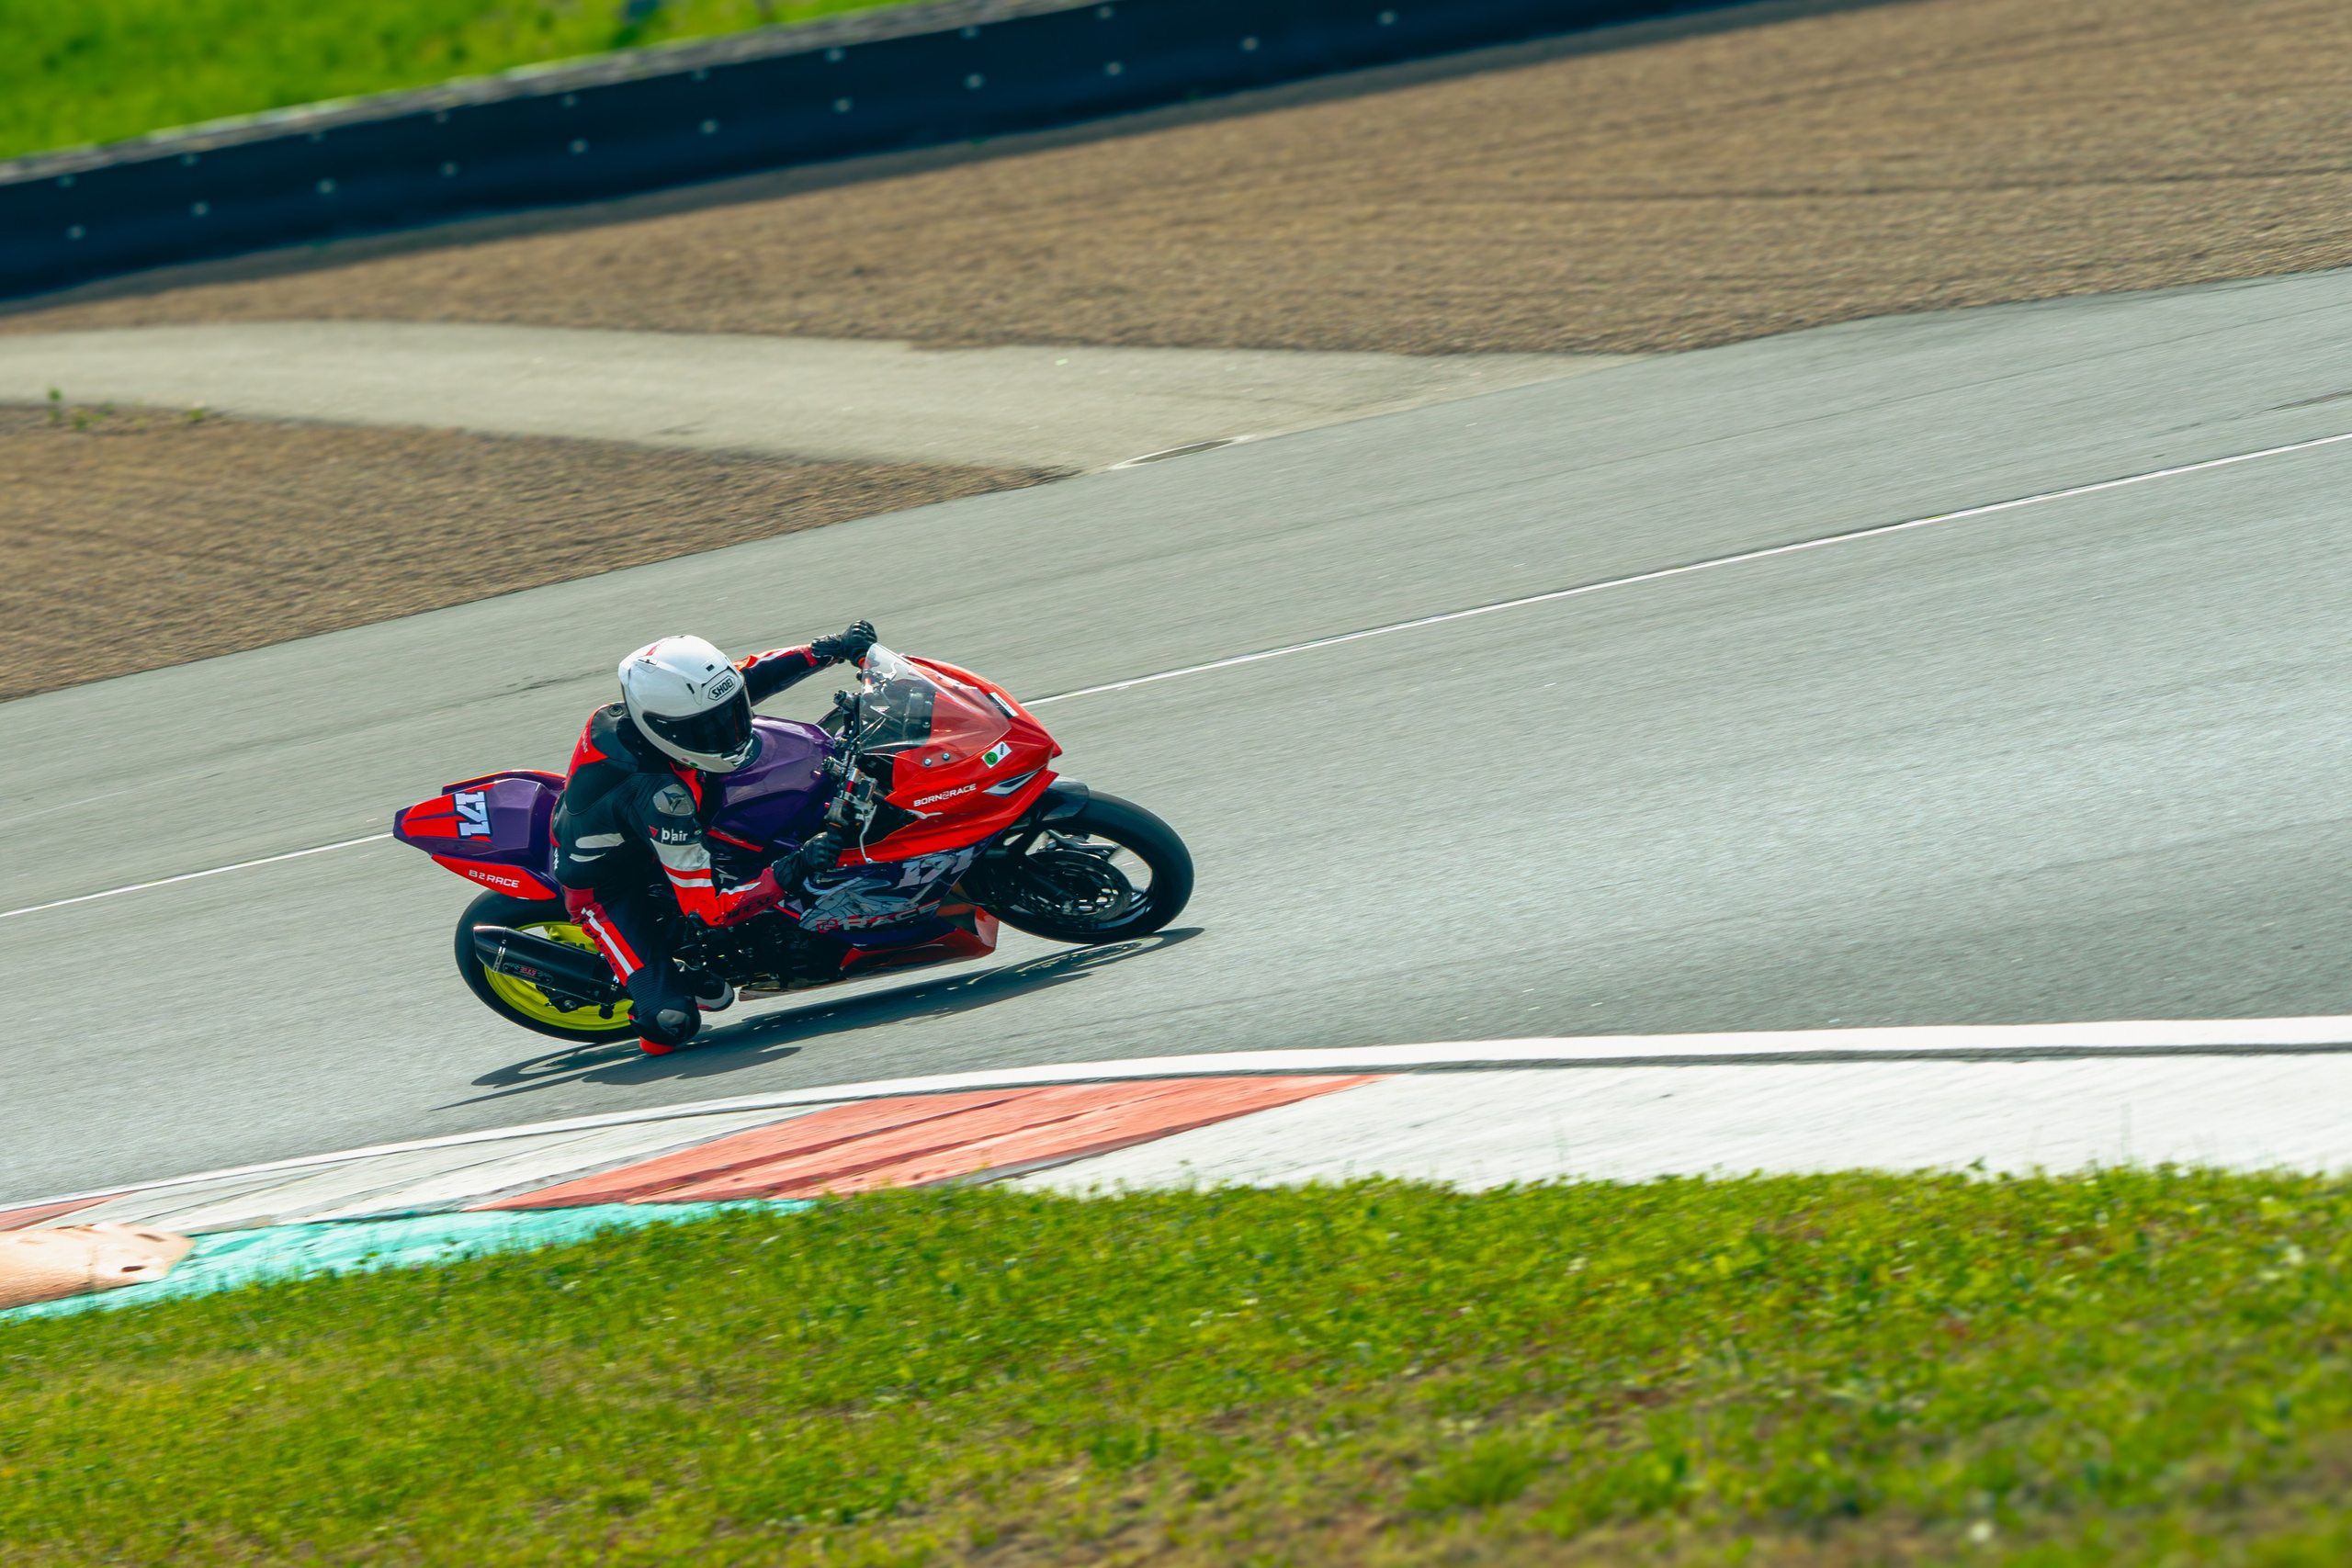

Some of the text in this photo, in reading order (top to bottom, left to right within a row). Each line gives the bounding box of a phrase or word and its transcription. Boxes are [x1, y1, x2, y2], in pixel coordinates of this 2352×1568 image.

[711, 678, 734, 698] SHOEI
[913, 784, 977, 807] BORN2RACE
[455, 791, 491, 836] 171
